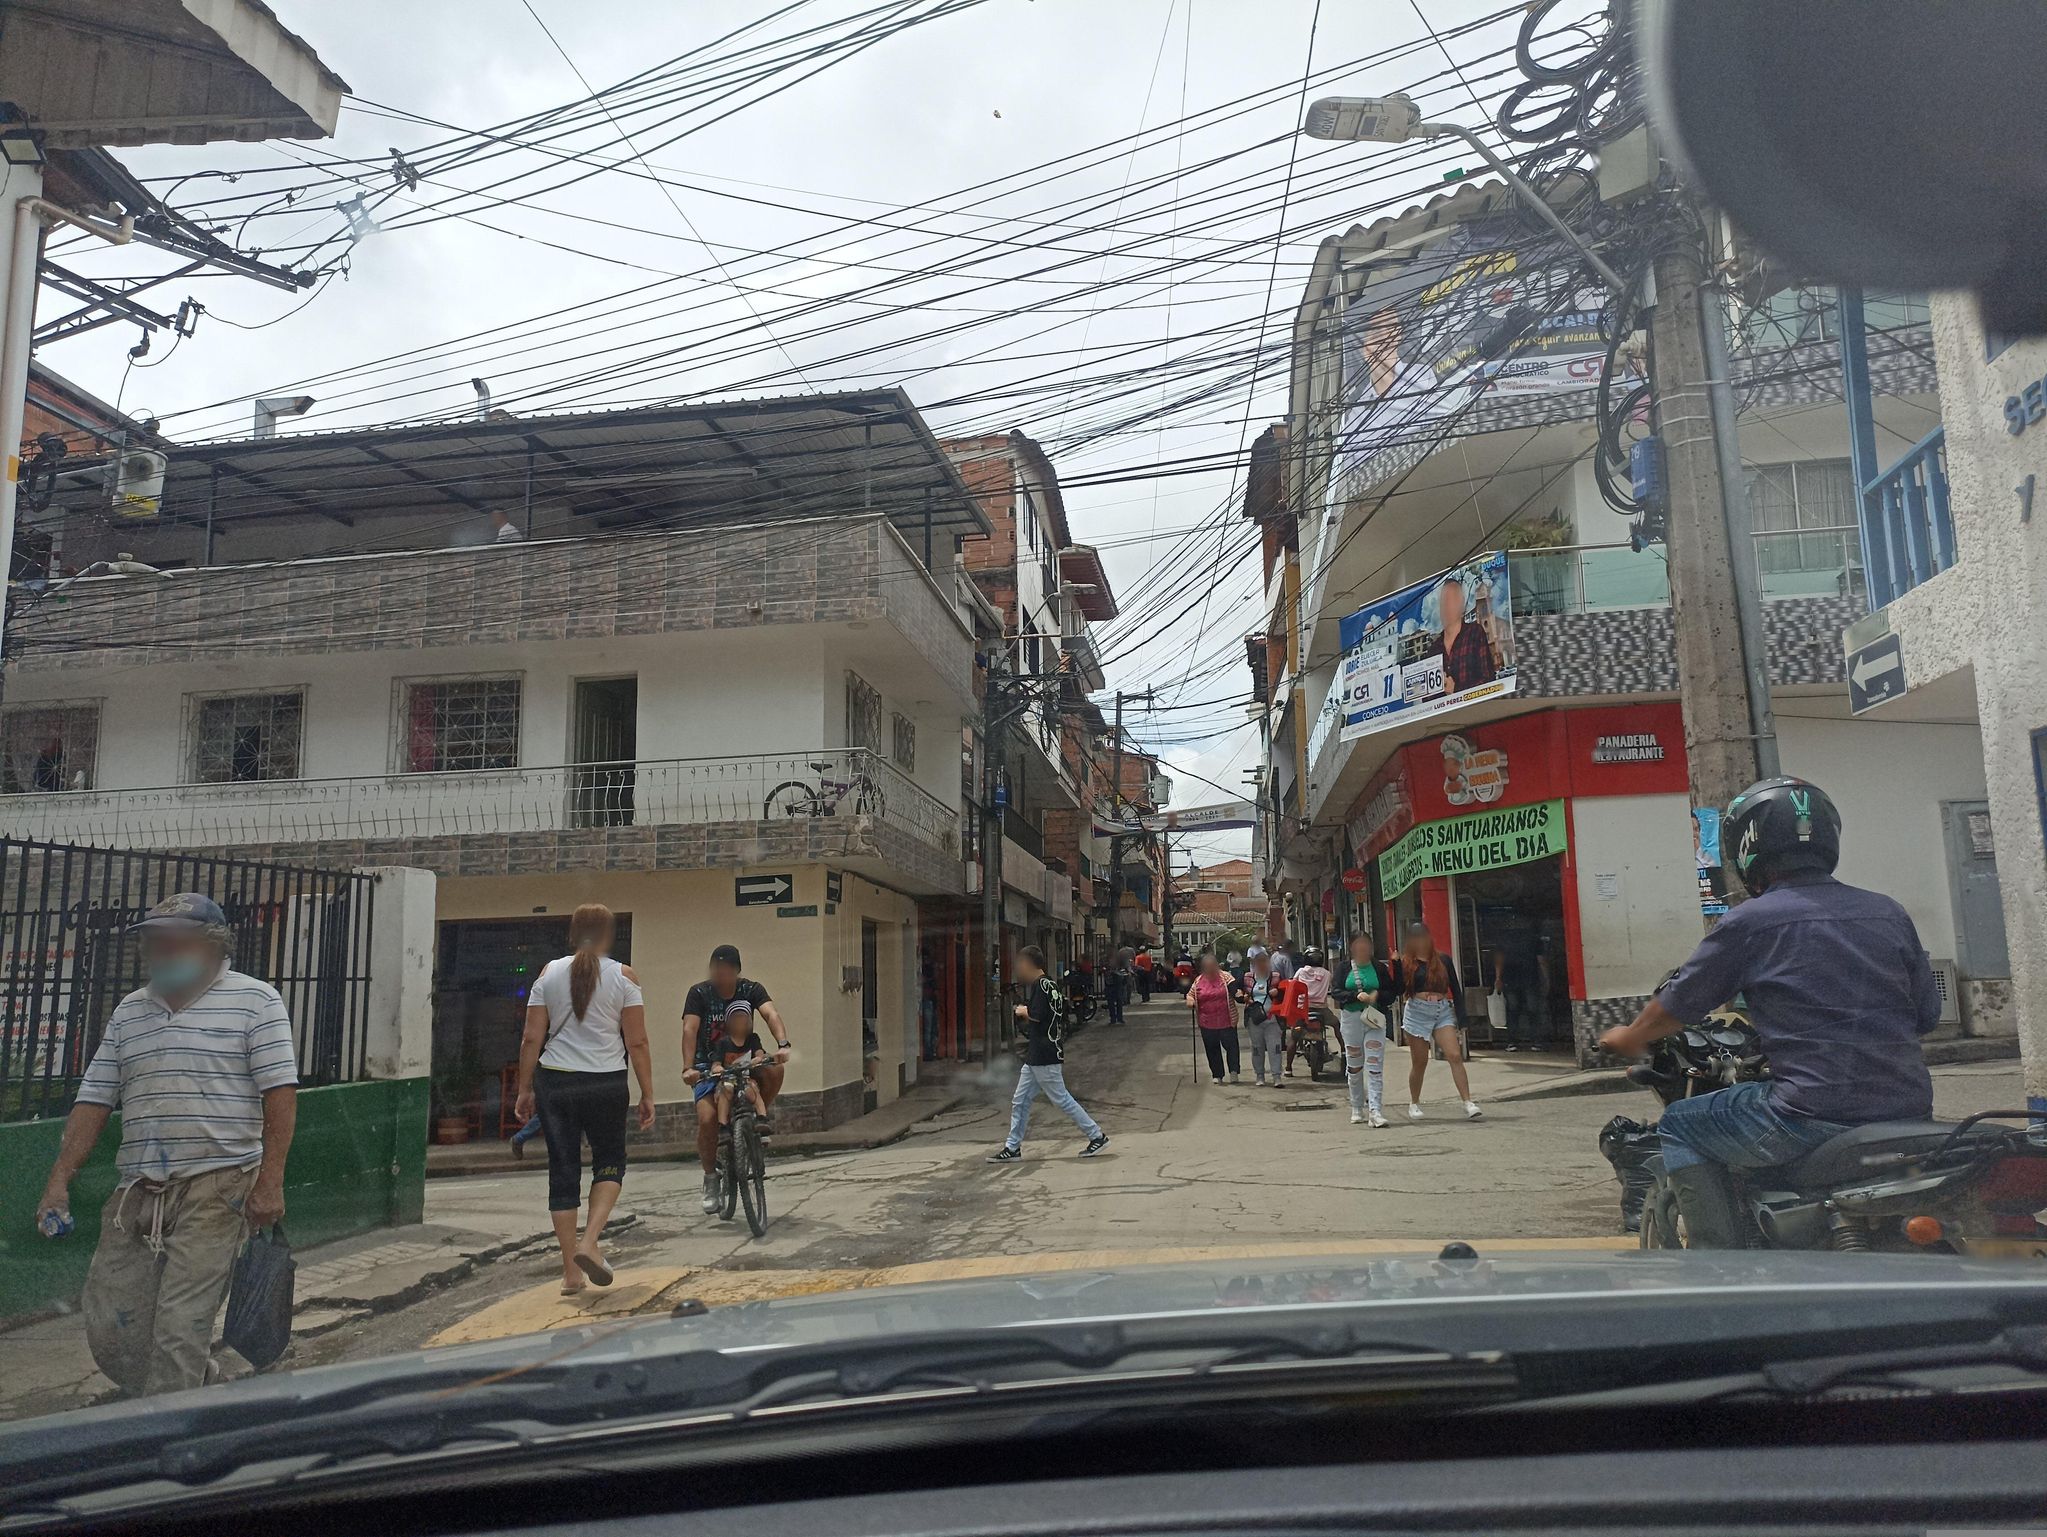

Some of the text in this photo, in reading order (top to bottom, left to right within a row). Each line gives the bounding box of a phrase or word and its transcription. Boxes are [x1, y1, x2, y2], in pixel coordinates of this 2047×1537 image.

[1564, 331, 1611, 343] avanzano
[1500, 361, 1549, 373] CENTRO
[1428, 669, 1443, 690] 66
[1362, 705, 1389, 720] CONCEJO
[1433, 701, 1446, 711] LUIS
[1598, 733, 1657, 749] PANADERIA
[1593, 746, 1665, 762] ESTAURANTE
[1437, 804, 1549, 847] SANTUARIANOS
[1431, 841, 1473, 873] MENÚ
[1478, 839, 1511, 867] DEL
[1515, 832, 1550, 860] DIA
